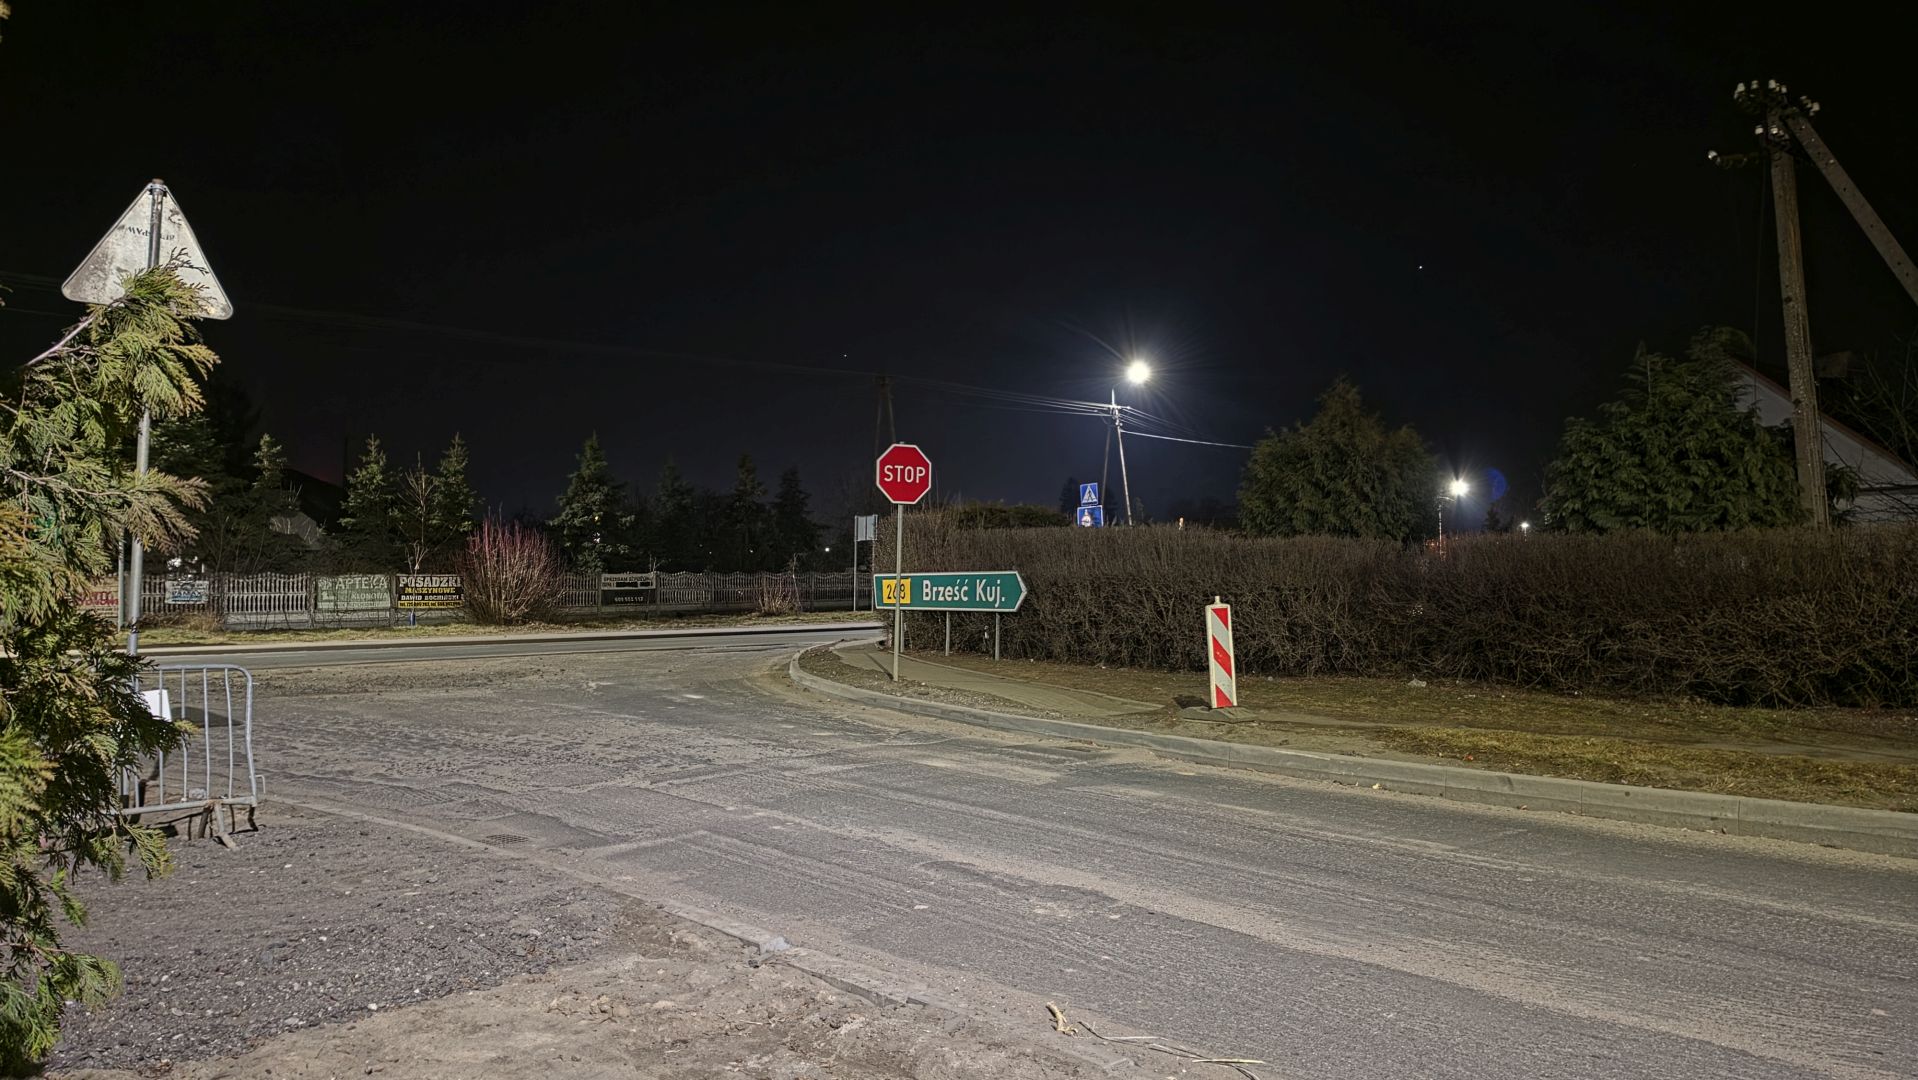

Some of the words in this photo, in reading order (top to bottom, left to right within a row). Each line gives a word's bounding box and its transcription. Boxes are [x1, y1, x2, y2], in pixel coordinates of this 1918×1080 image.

[884, 465, 926, 484] STOP
[335, 577, 388, 590] APTEKA
[399, 576, 462, 588] POSADZKI
[922, 579, 968, 602] Brześć
[976, 579, 1006, 608] Kuj.
